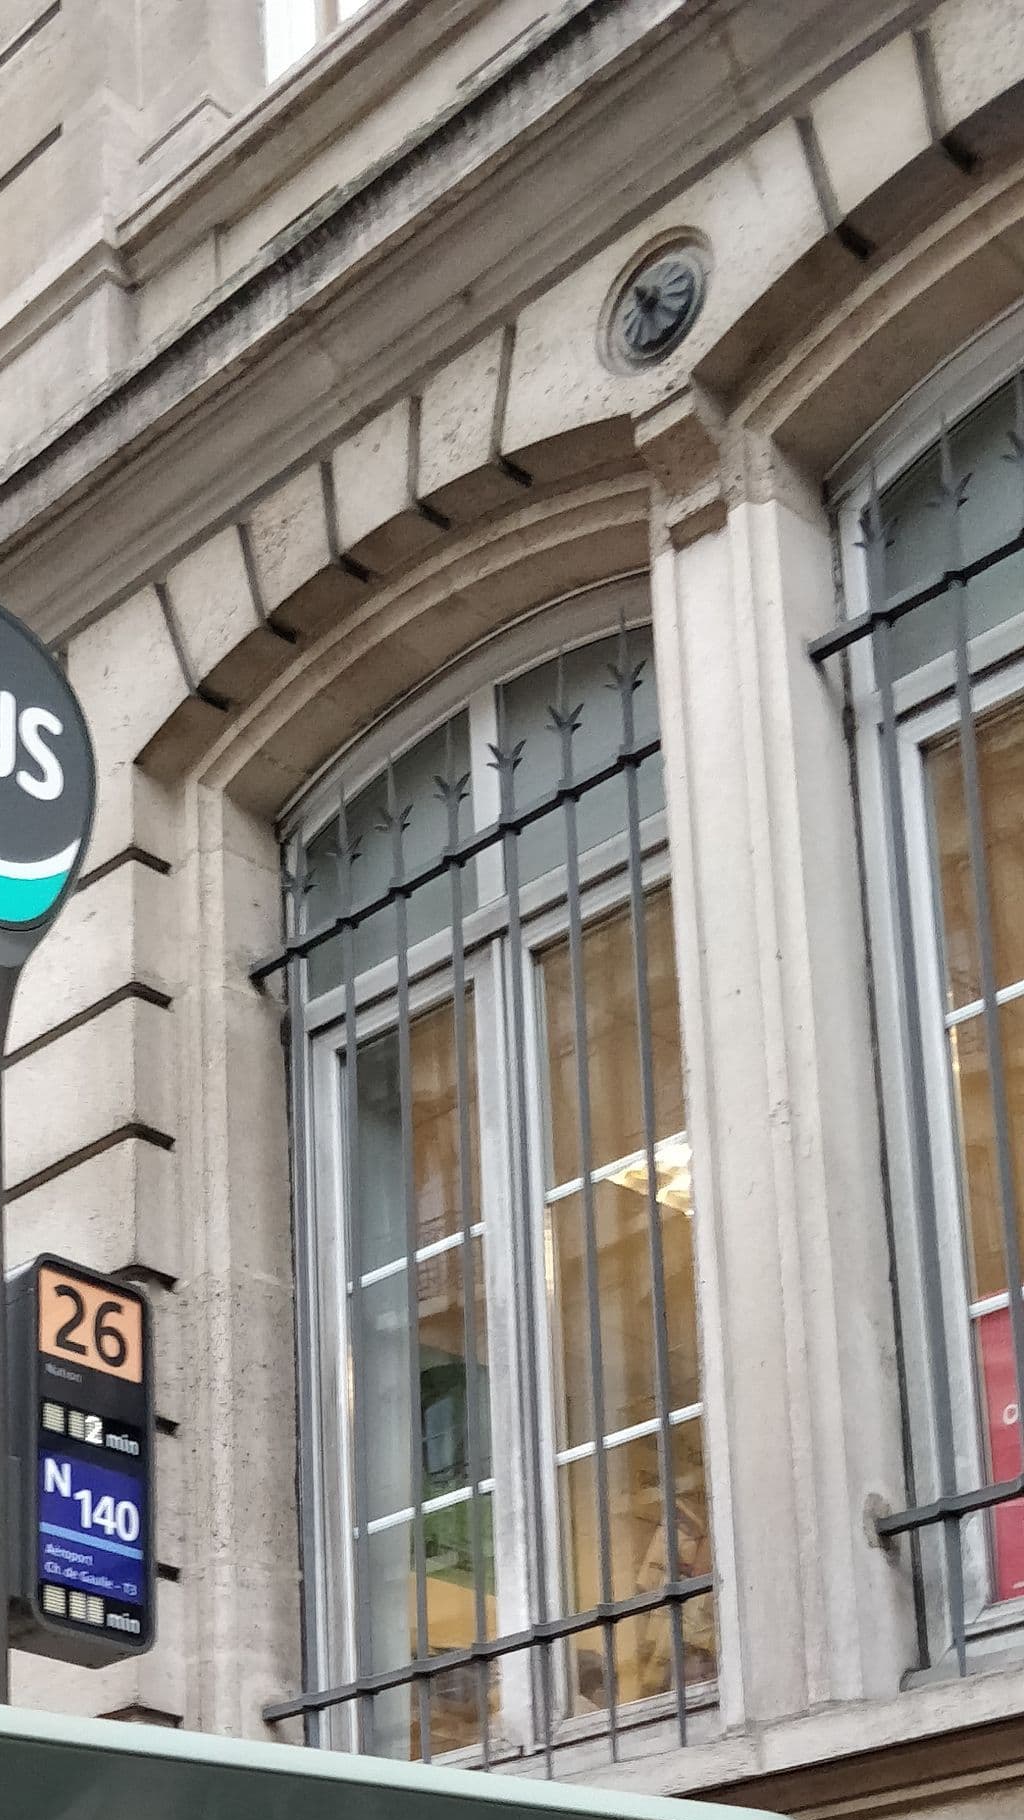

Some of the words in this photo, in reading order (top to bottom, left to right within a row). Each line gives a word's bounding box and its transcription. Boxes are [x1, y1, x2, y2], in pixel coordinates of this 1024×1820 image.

[54, 1284, 127, 1367] 26
[85, 1415, 104, 1445] 2
[106, 1433, 139, 1455] min
[73, 1489, 140, 1542] 140
[106, 1612, 141, 1635] min
